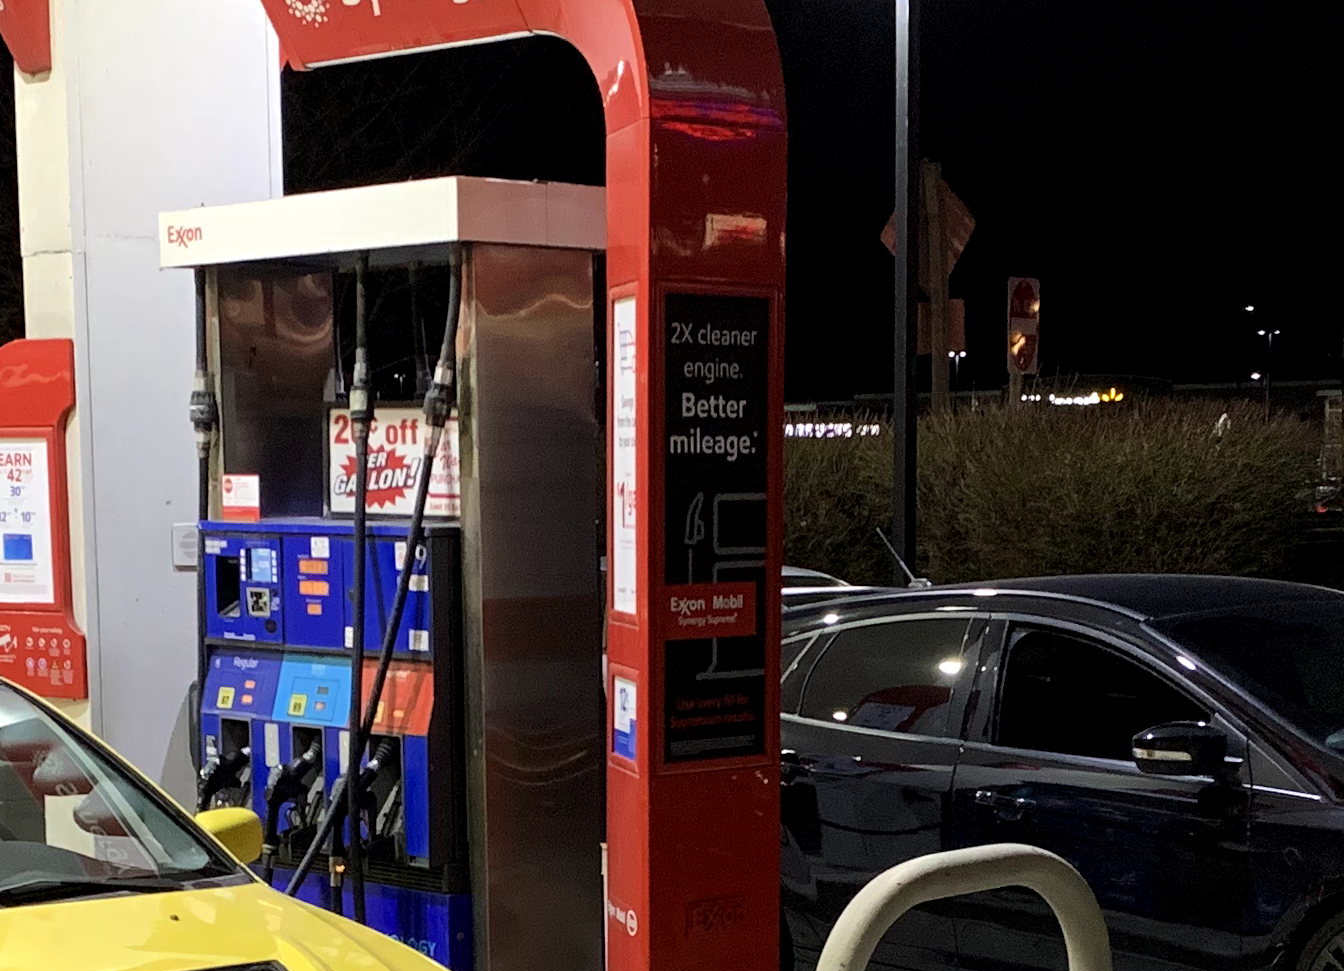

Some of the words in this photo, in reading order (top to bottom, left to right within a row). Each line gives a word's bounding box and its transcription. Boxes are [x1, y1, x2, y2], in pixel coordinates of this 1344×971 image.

[167, 225, 203, 249] Exxon
[671, 321, 693, 344] 2X
[697, 322, 758, 346] cleaner
[683, 358, 744, 385] engine.
[682, 392, 747, 418] Better
[385, 418, 418, 445] off
[6, 468, 23, 482] 42
[334, 456, 422, 496] GALON!
[415, 544, 427, 569] 9
[670, 596, 706, 616] Exxon
[712, 594, 744, 610] Mobil
[233, 656, 259, 671] Regular
